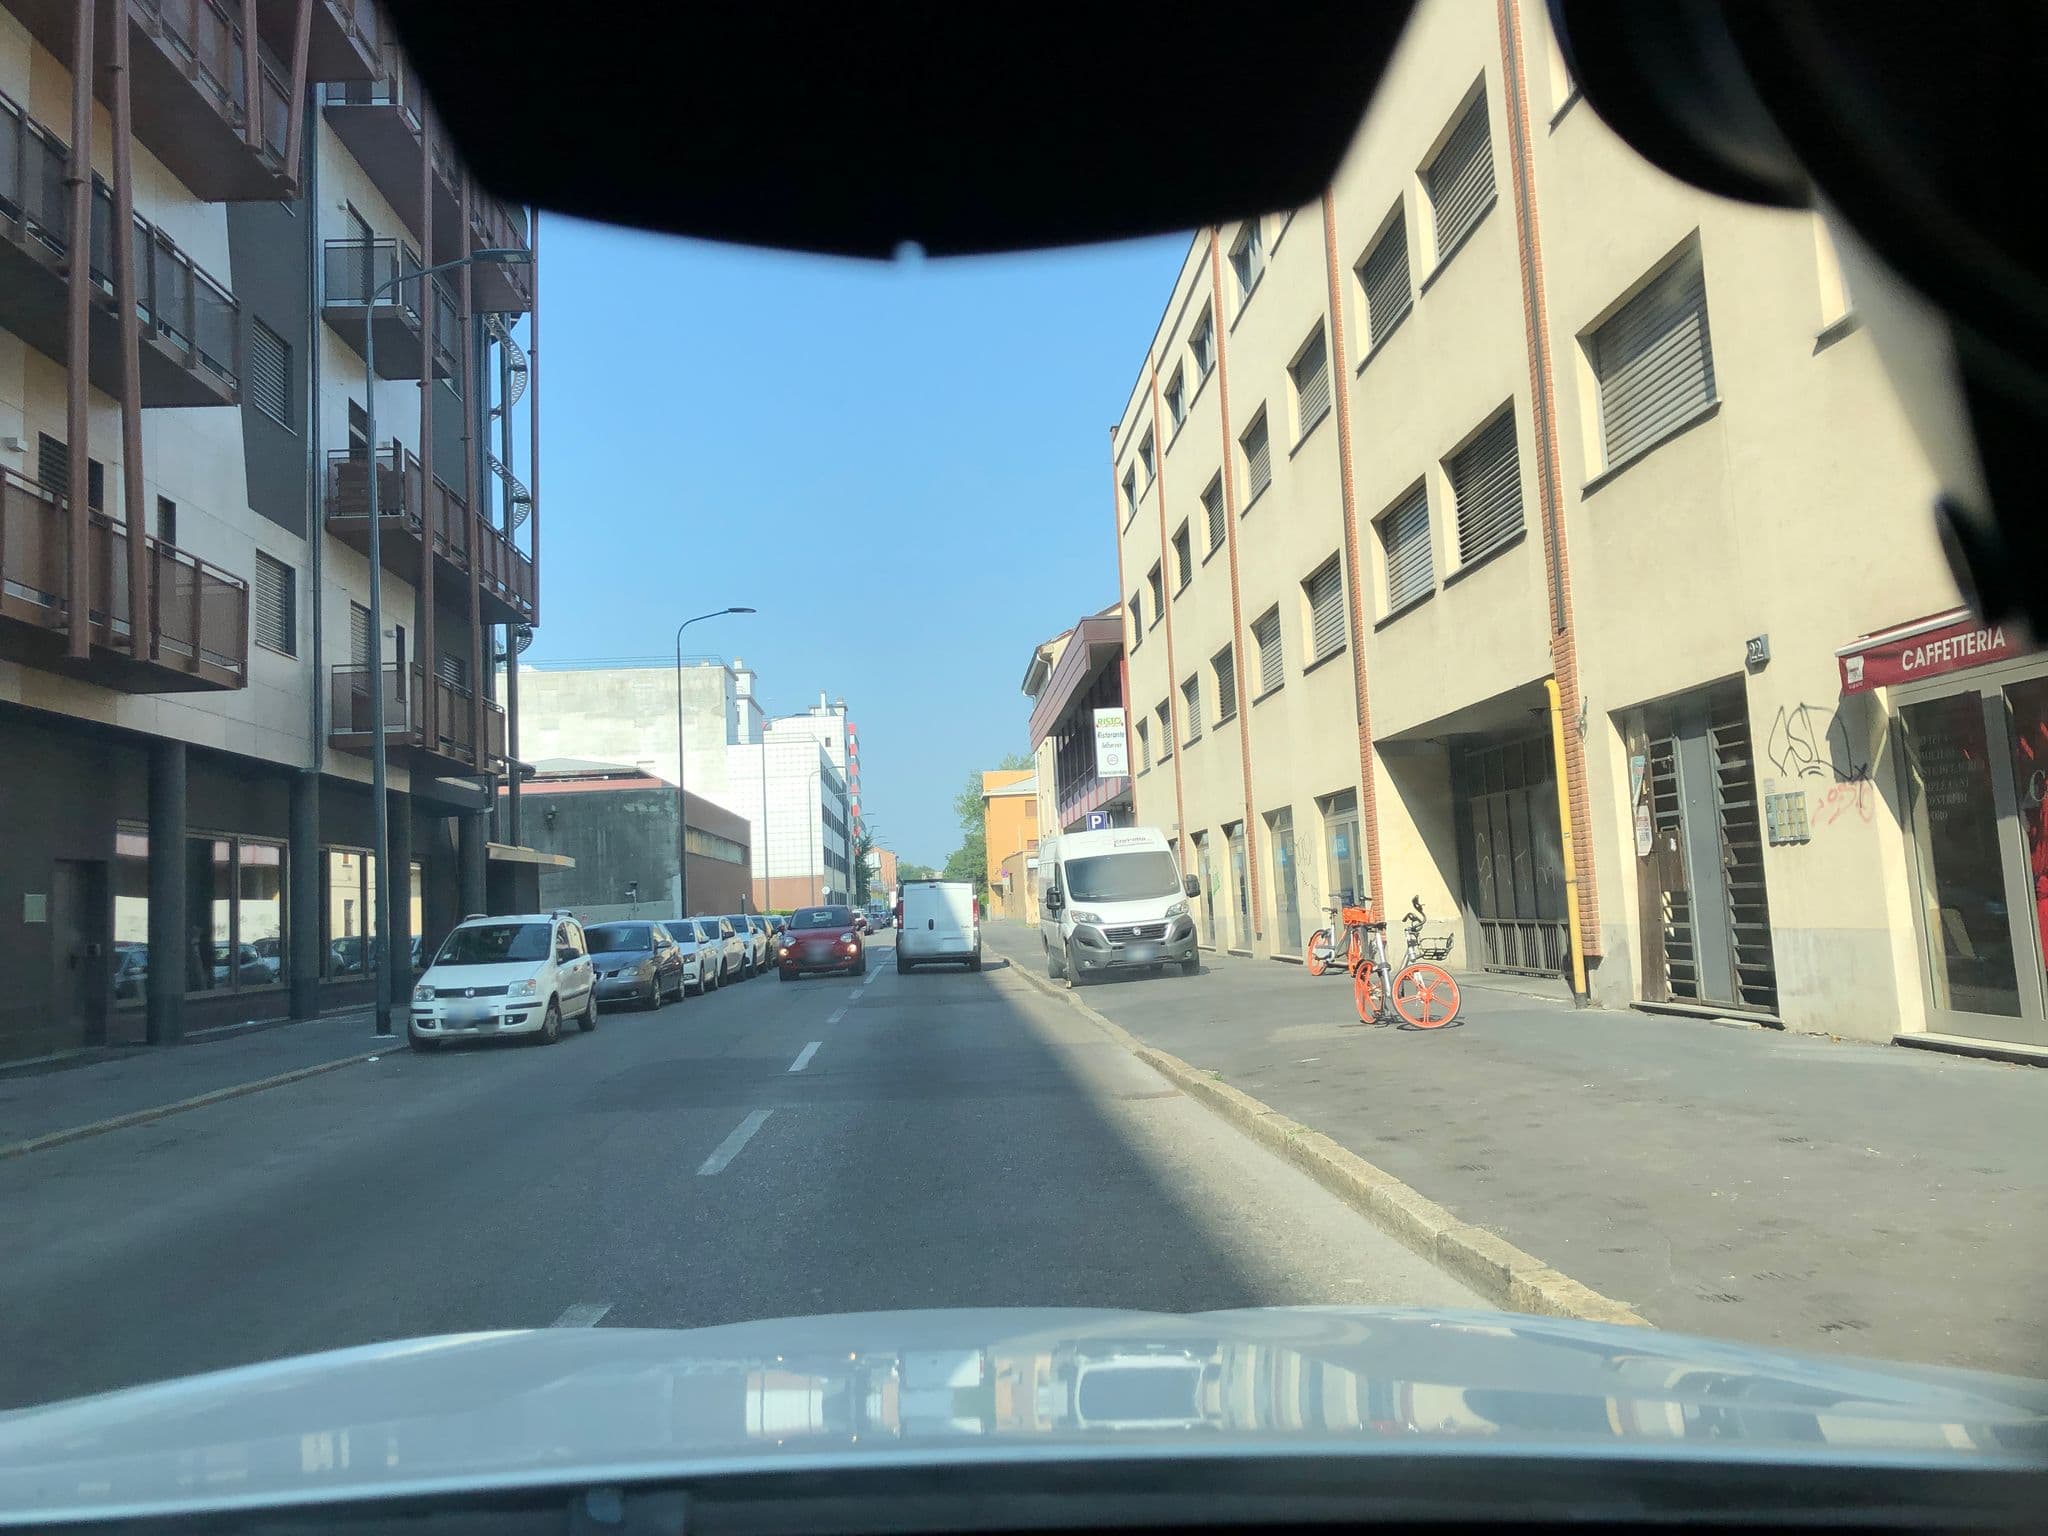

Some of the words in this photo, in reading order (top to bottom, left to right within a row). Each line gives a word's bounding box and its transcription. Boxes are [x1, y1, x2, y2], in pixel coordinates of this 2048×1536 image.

[1749, 640, 1764, 660] 22
[1902, 626, 2007, 672] CAFFETTERIA
[1091, 815, 1102, 829] P
